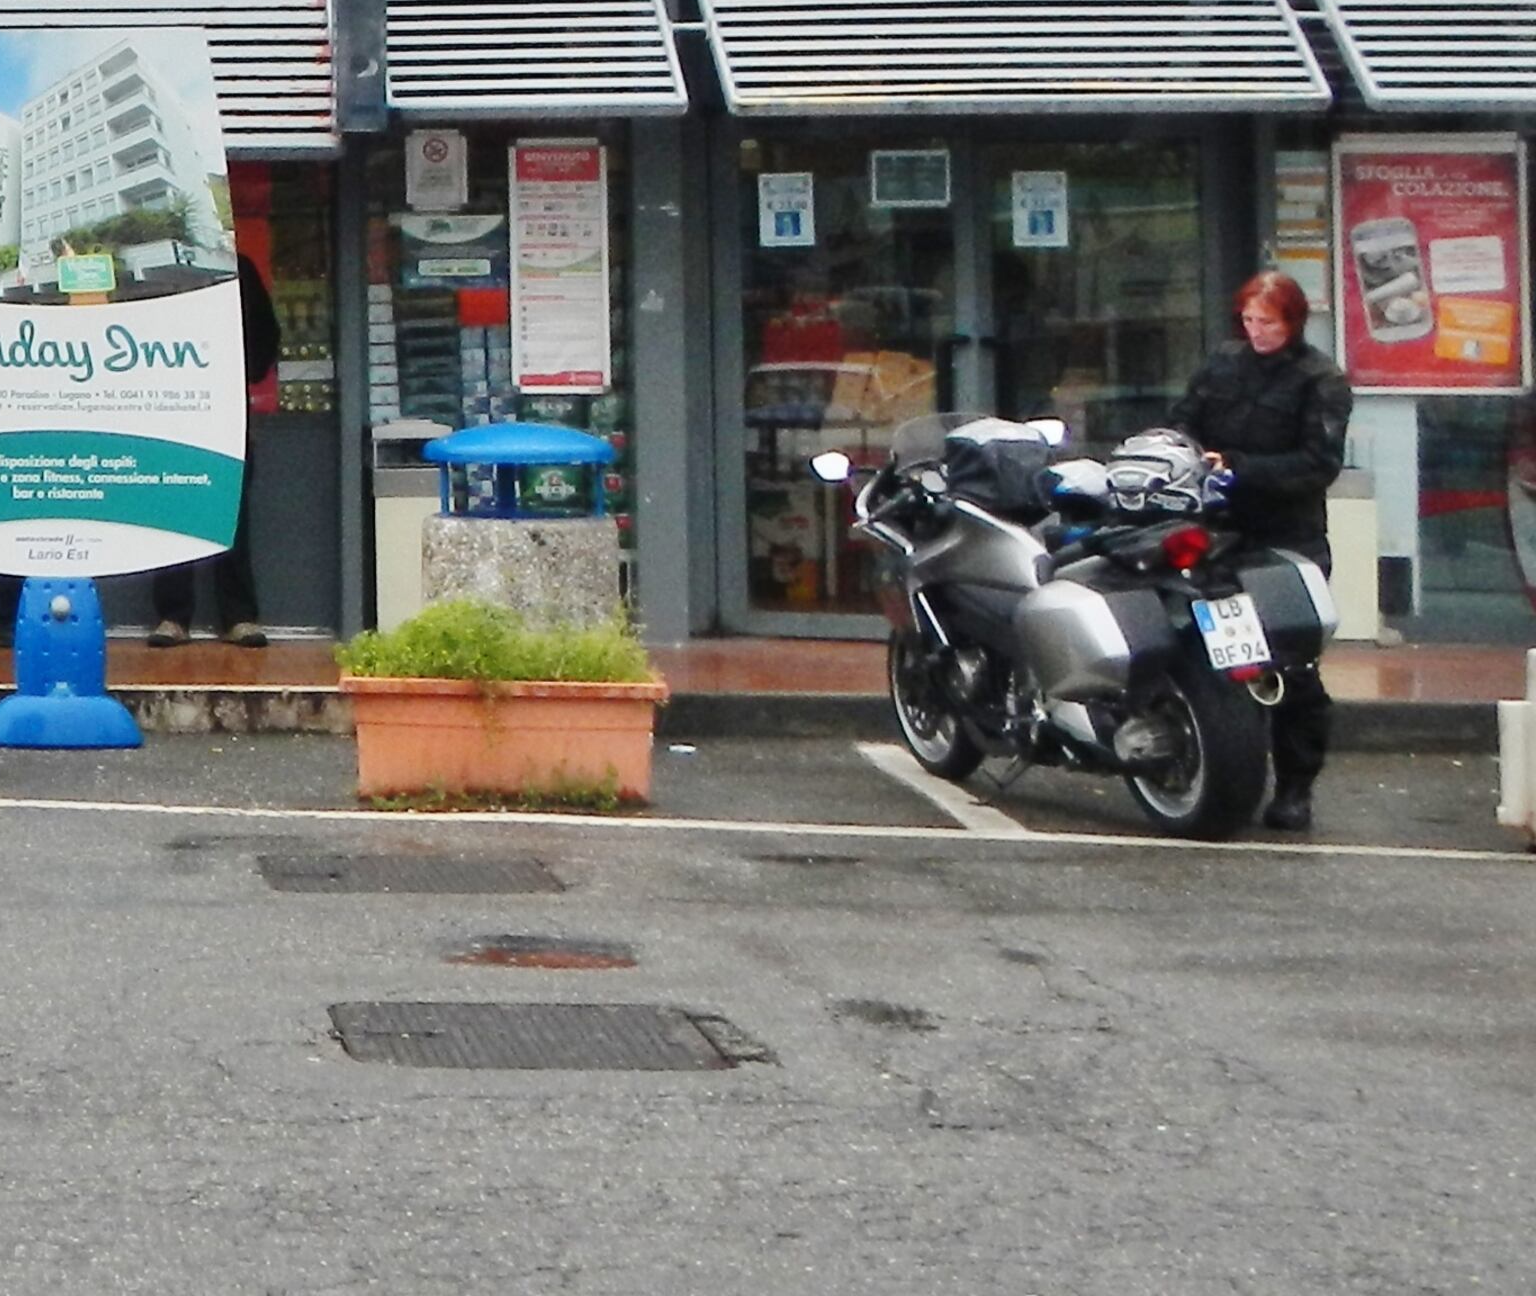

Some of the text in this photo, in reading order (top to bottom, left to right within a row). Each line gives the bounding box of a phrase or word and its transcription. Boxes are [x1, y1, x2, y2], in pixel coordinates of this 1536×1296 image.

[103, 324, 210, 372] Inn
[68, 454, 98, 470] degli
[100, 456, 137, 470] ospiti:
[0, 473, 9, 483] e
[11, 474, 41, 483] zona
[43, 470, 85, 484] fitness,
[87, 472, 160, 484] connessione
[162, 472, 212, 486] internet,
[12, 486, 105, 500] bar e ristorante
[28, 548, 89, 560] Lario Est
